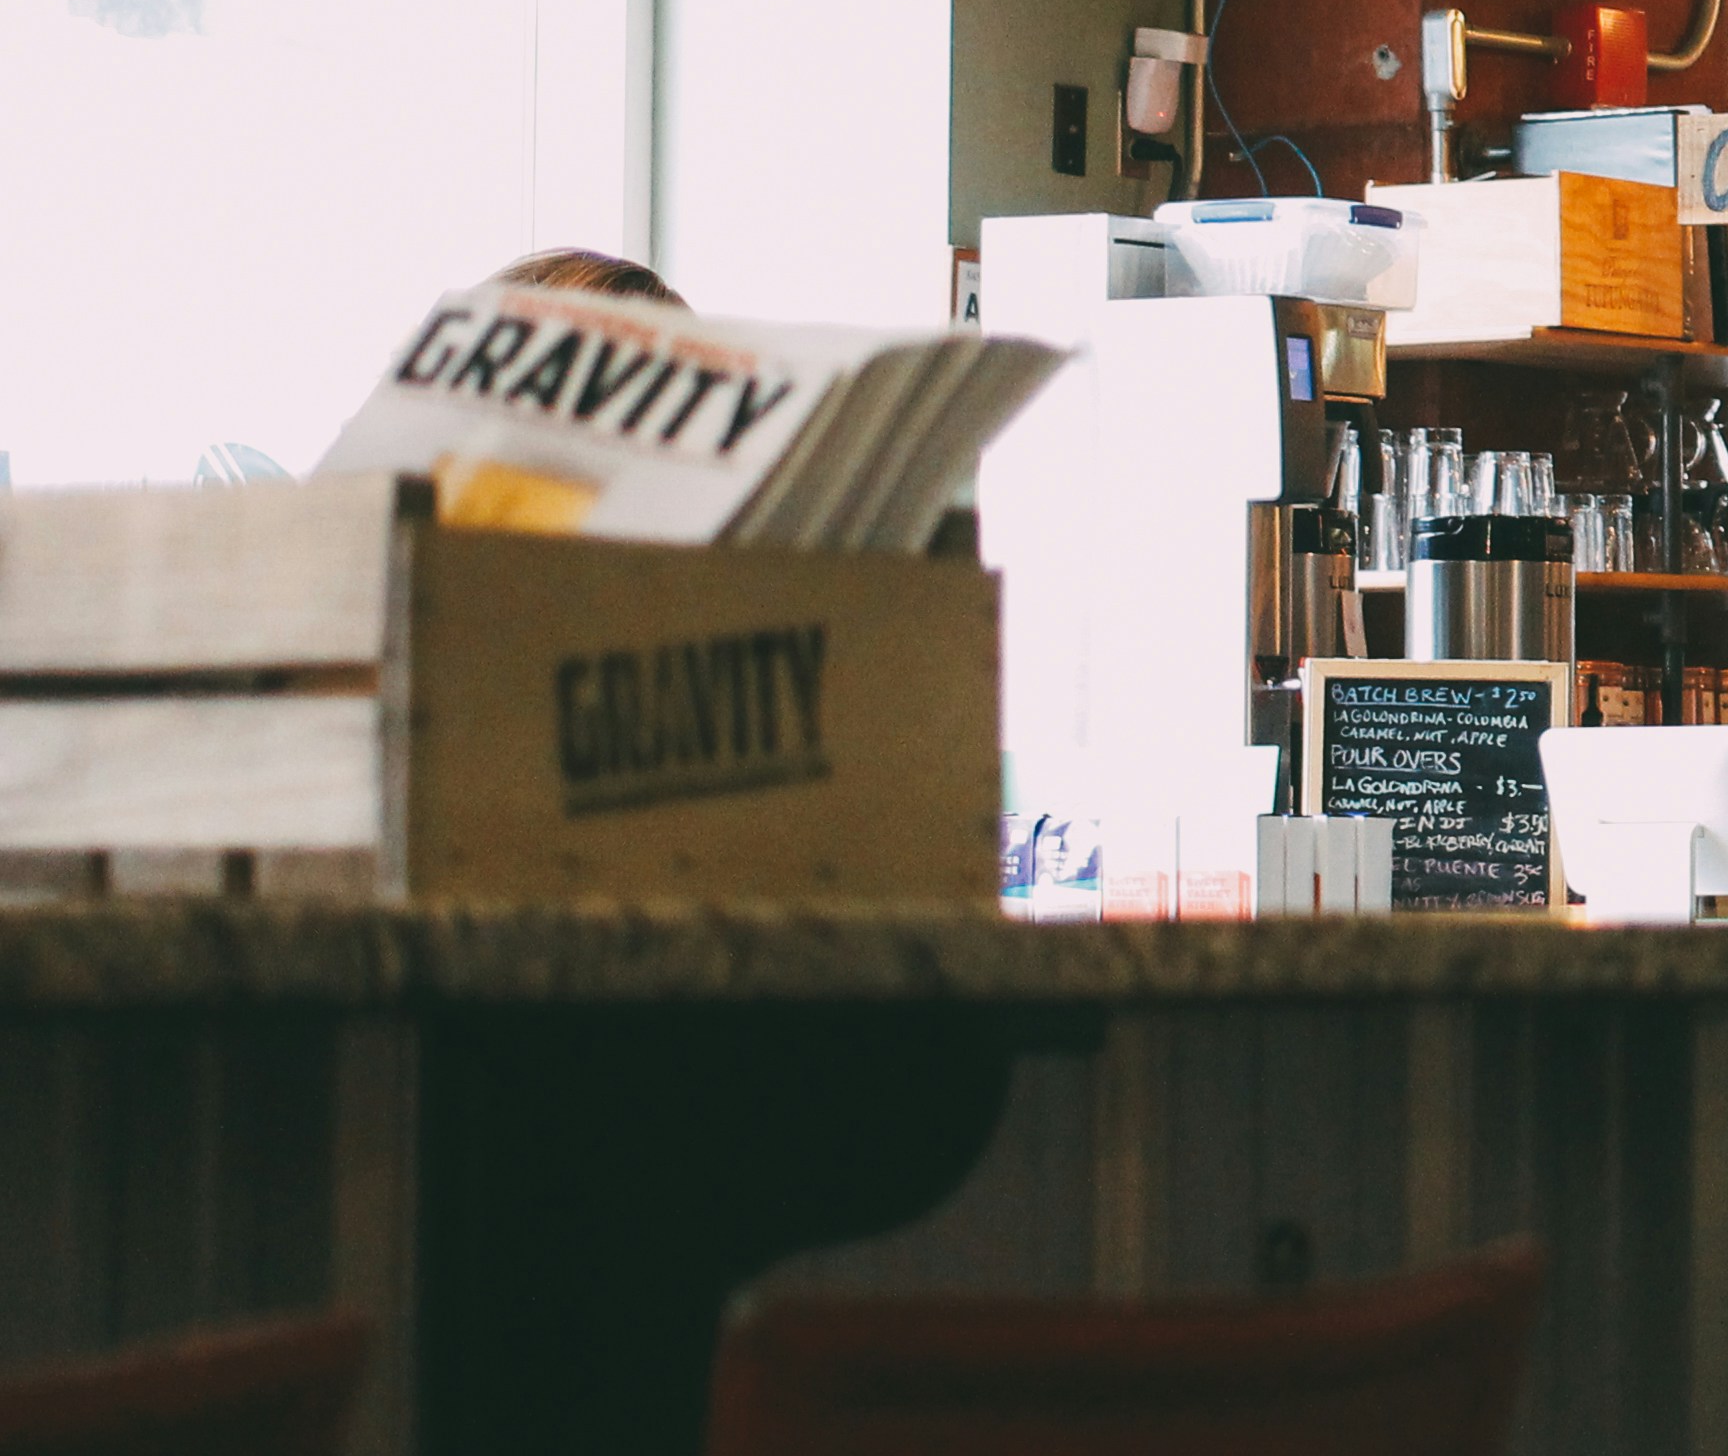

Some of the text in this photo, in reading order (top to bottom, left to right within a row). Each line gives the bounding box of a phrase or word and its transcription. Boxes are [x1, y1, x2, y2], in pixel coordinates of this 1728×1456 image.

[1586, 29, 1595, 81] FIRE
[395, 309, 794, 456] GRAVITY
[556, 622, 827, 782] GRAVITY
[1332, 683, 1397, 704] BATCH
[1405, 686, 1472, 704] BREW
[1457, 712, 1528, 730] COLOMBIA
[1332, 744, 1461, 775] POUR OVERS
[1332, 776, 1354, 792] LA
[1424, 858, 1501, 878] PUENTE
